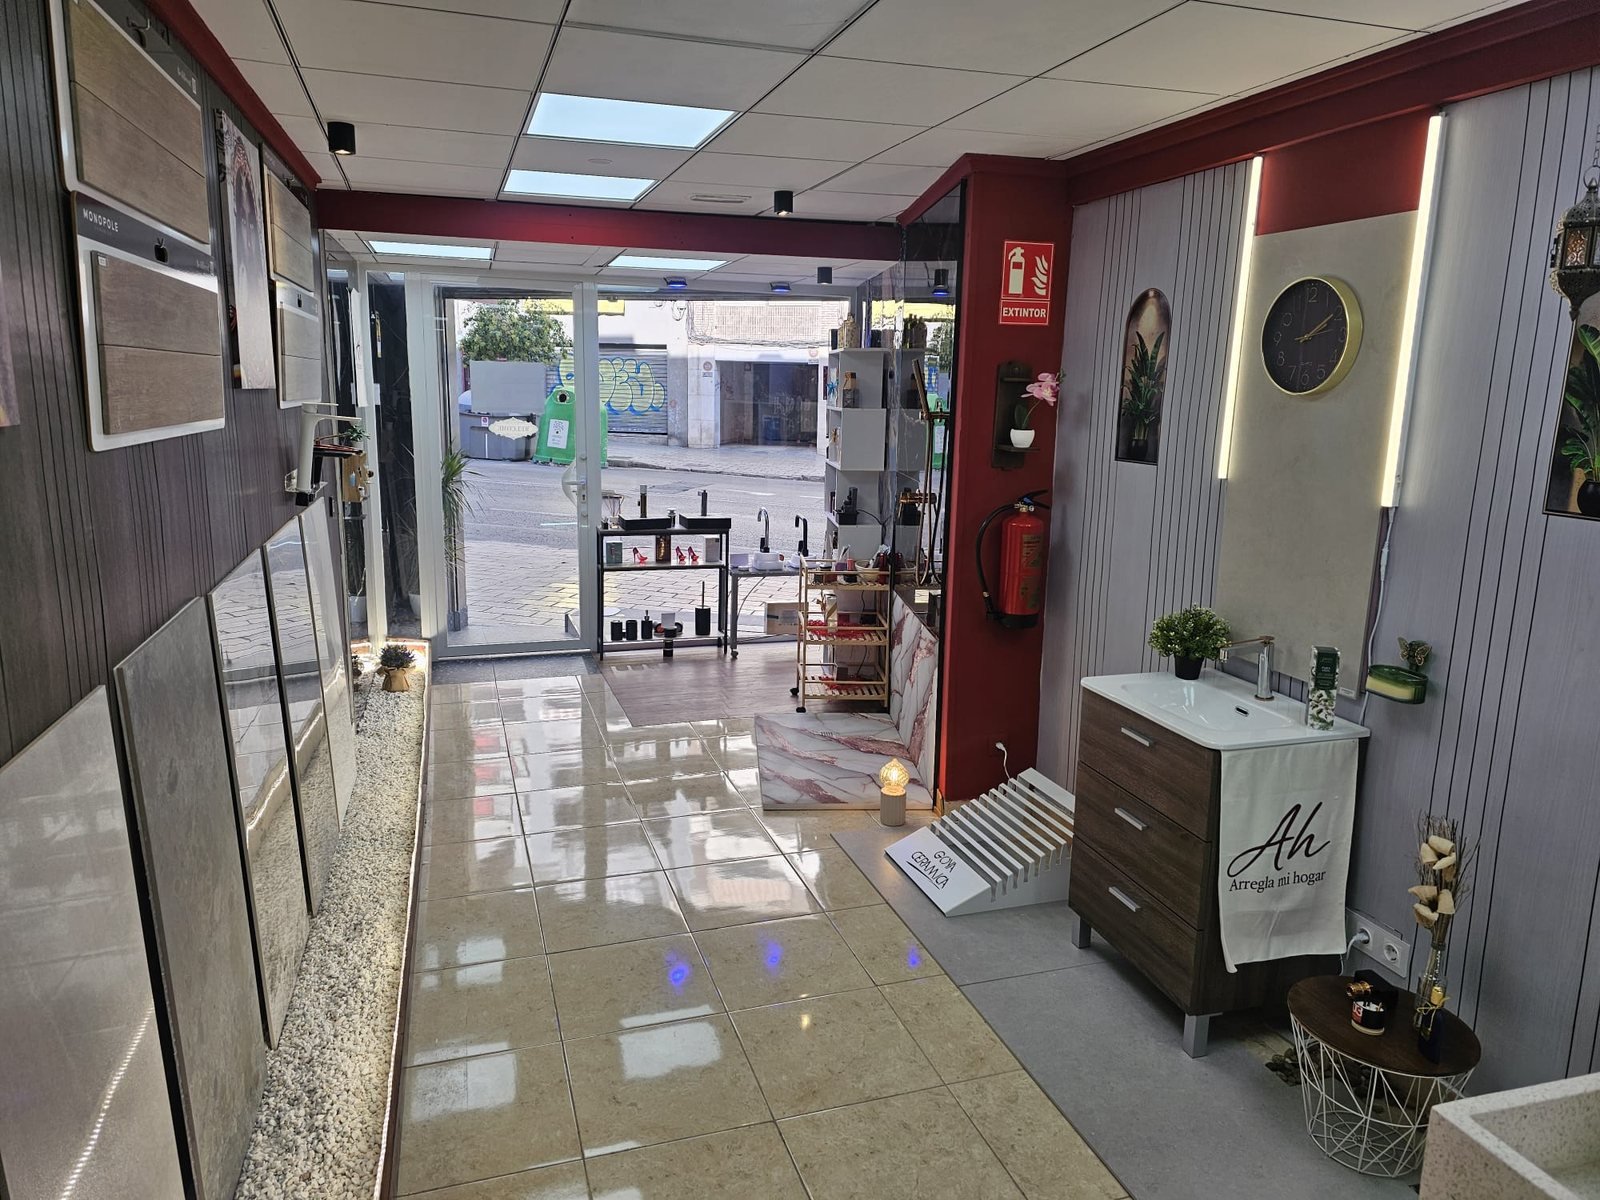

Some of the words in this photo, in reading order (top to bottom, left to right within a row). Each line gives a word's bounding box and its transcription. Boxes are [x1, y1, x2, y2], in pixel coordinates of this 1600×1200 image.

[82, 207, 119, 233] MONOPOLE
[1307, 287, 1318, 303] 12
[1002, 307, 1047, 318] EXTINTOR
[1333, 305, 1343, 321] 2
[1273, 331, 1283, 347] 9
[1339, 326, 1347, 343] 3
[1276, 351, 1285, 367] 8
[1329, 349, 1338, 363] 4
[1288, 365, 1297, 384] 7
[1301, 369, 1310, 386] 6
[1316, 364, 1326, 380] 5
[1227, 801, 1331, 878] Ah
[911, 851, 949, 889] CERAMICA
[933, 850, 957, 873] GOYA
[1229, 876, 1275, 894] Arregla
[1277, 872, 1290, 887] mi
[1293, 871, 1327, 886] hogar
